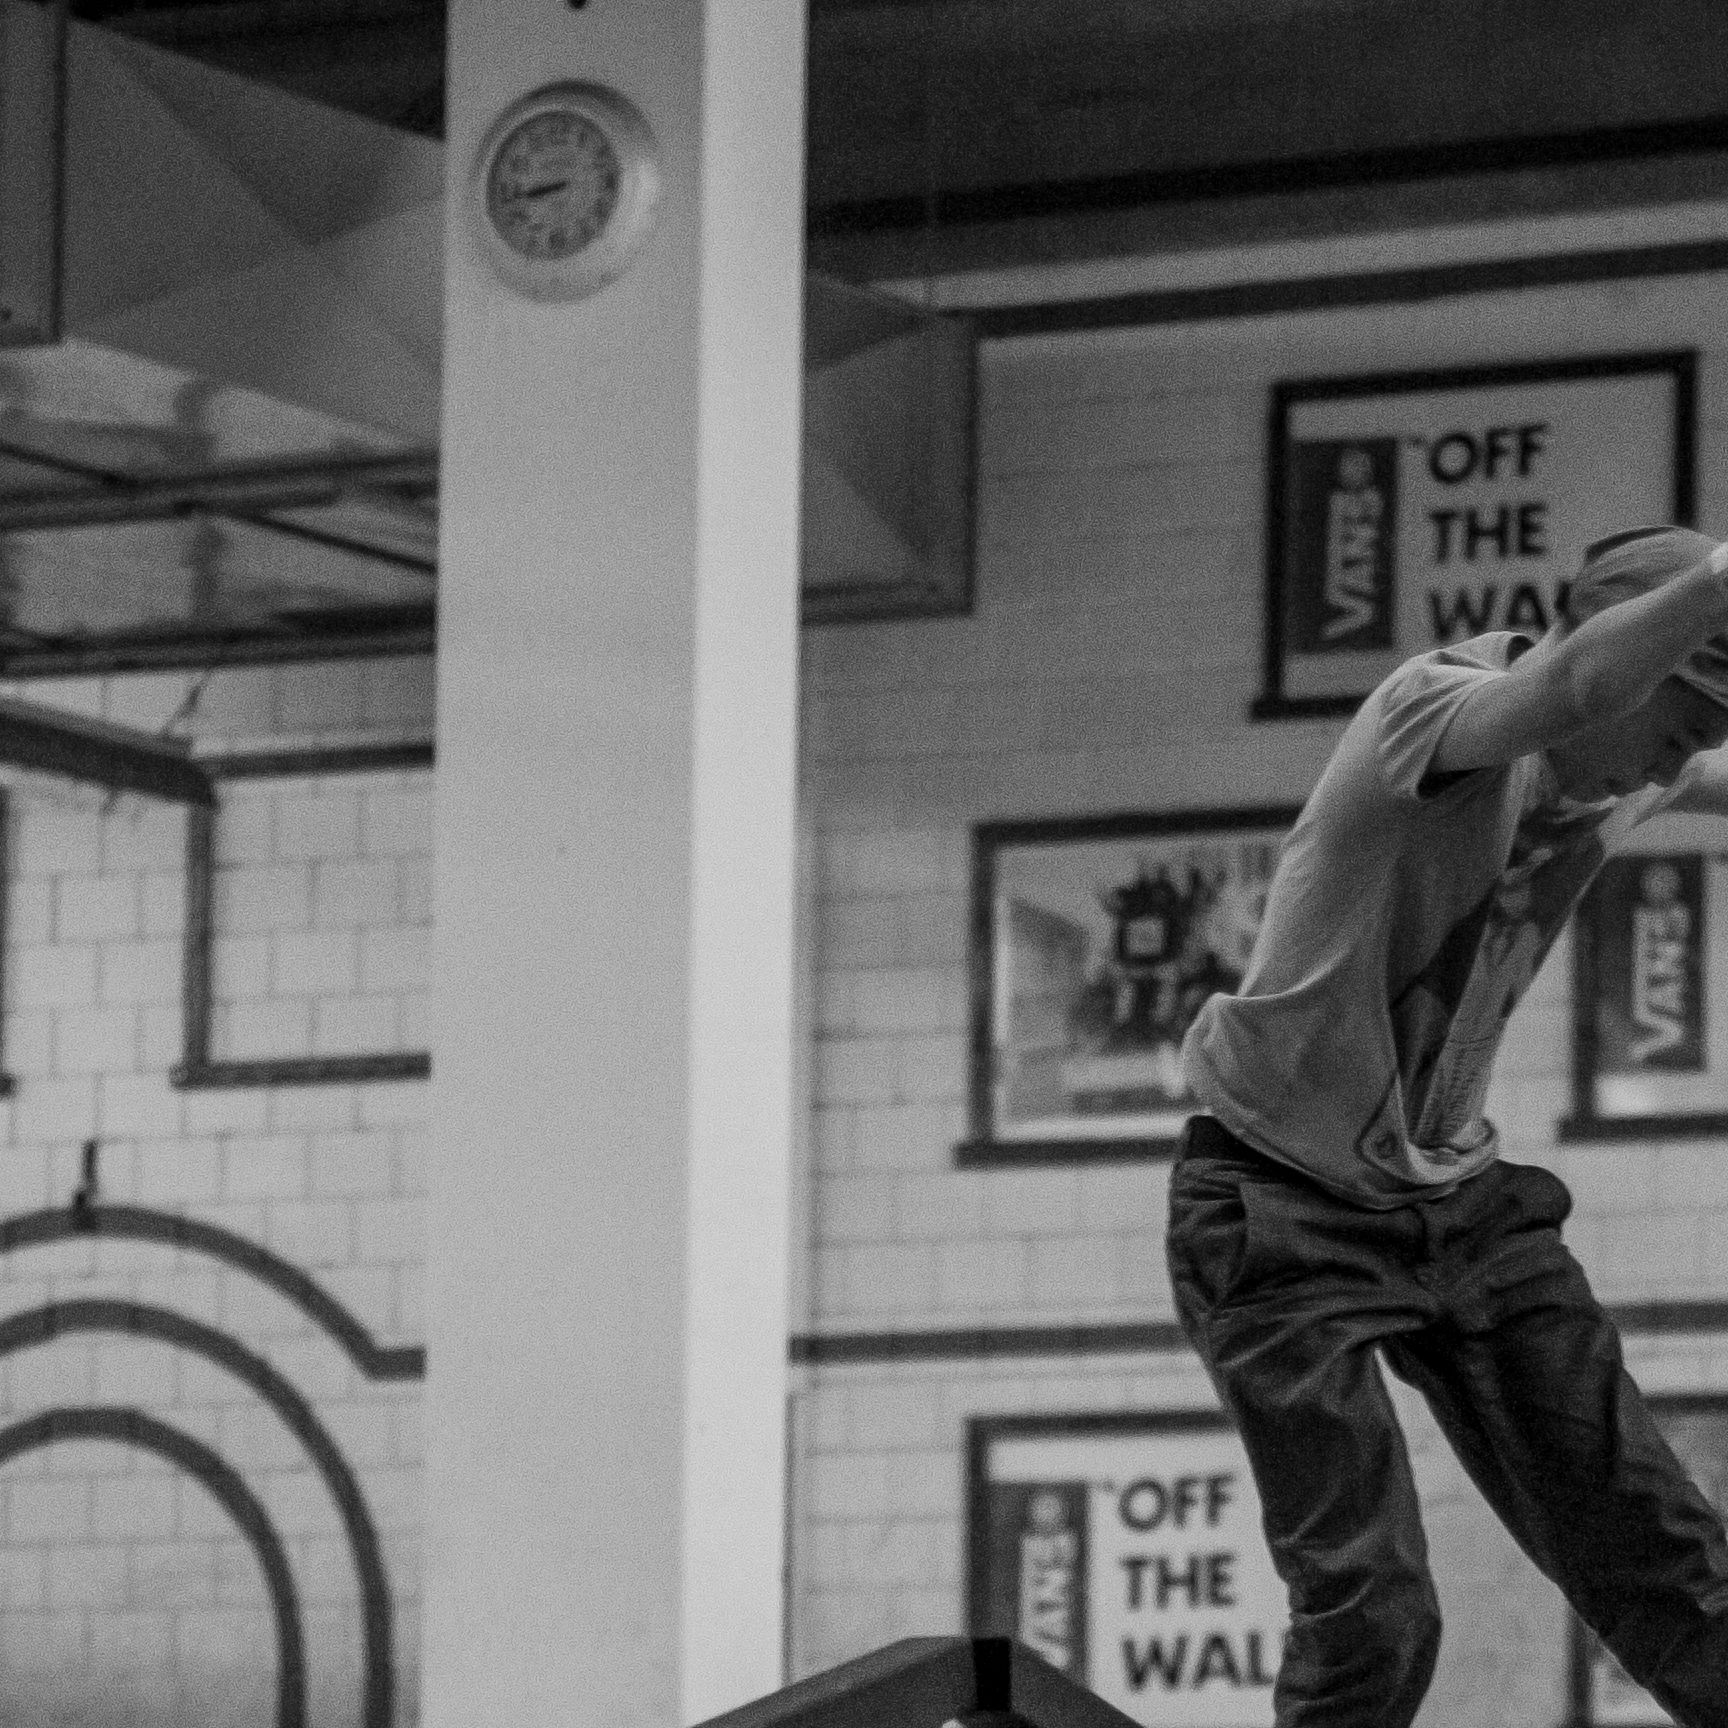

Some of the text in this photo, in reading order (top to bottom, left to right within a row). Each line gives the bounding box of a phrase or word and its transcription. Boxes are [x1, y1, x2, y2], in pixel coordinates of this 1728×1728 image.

[1323, 487, 1383, 641] VANS
[1428, 502, 1547, 565] THE
[1427, 582, 1575, 640] WA
[1627, 903, 1691, 1062] VANS
[1120, 1553, 1236, 1611] THE
[1122, 1628, 1275, 1693] WAL
